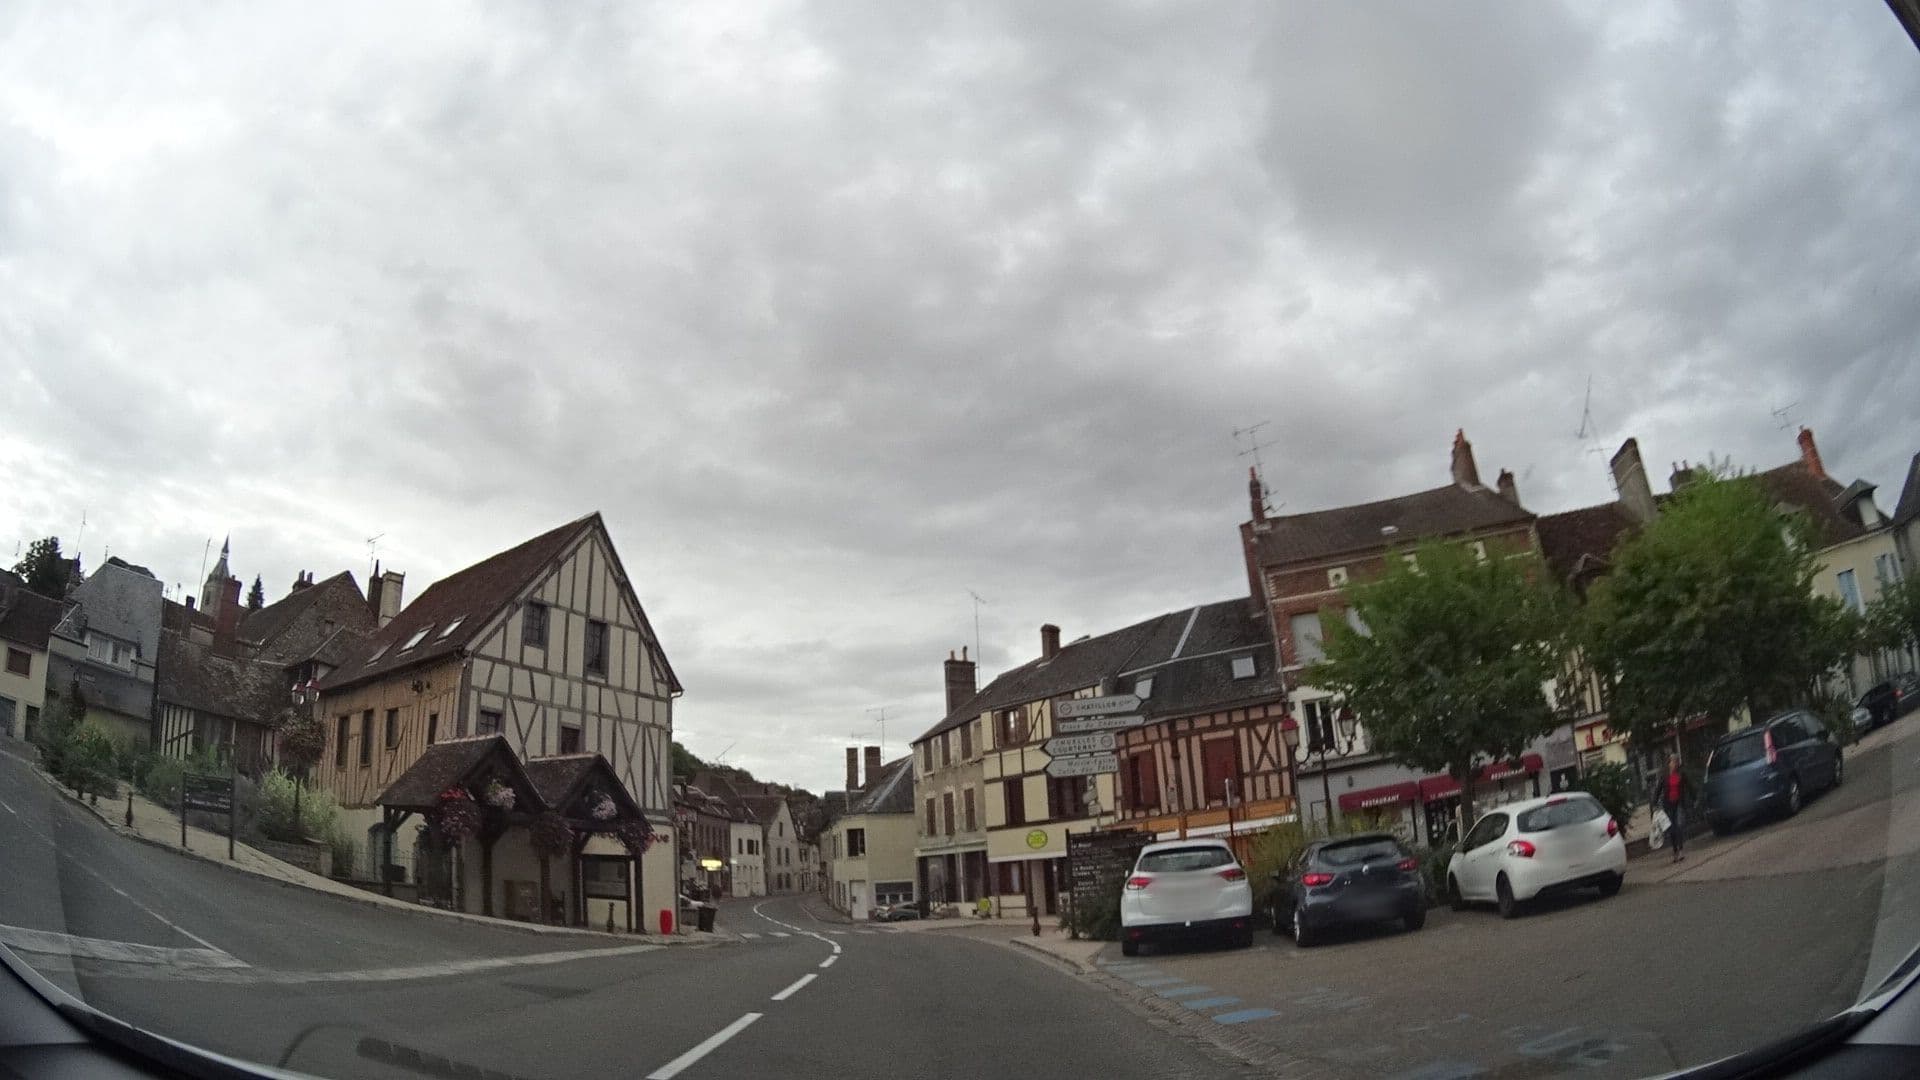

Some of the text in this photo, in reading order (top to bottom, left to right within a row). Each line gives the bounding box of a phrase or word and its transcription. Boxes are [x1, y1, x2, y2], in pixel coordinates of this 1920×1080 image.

[1052, 744, 1096, 753] COURTENAY
[1491, 766, 1526, 780] RESTAURANT
[1361, 794, 1399, 808] RESTAURANT
